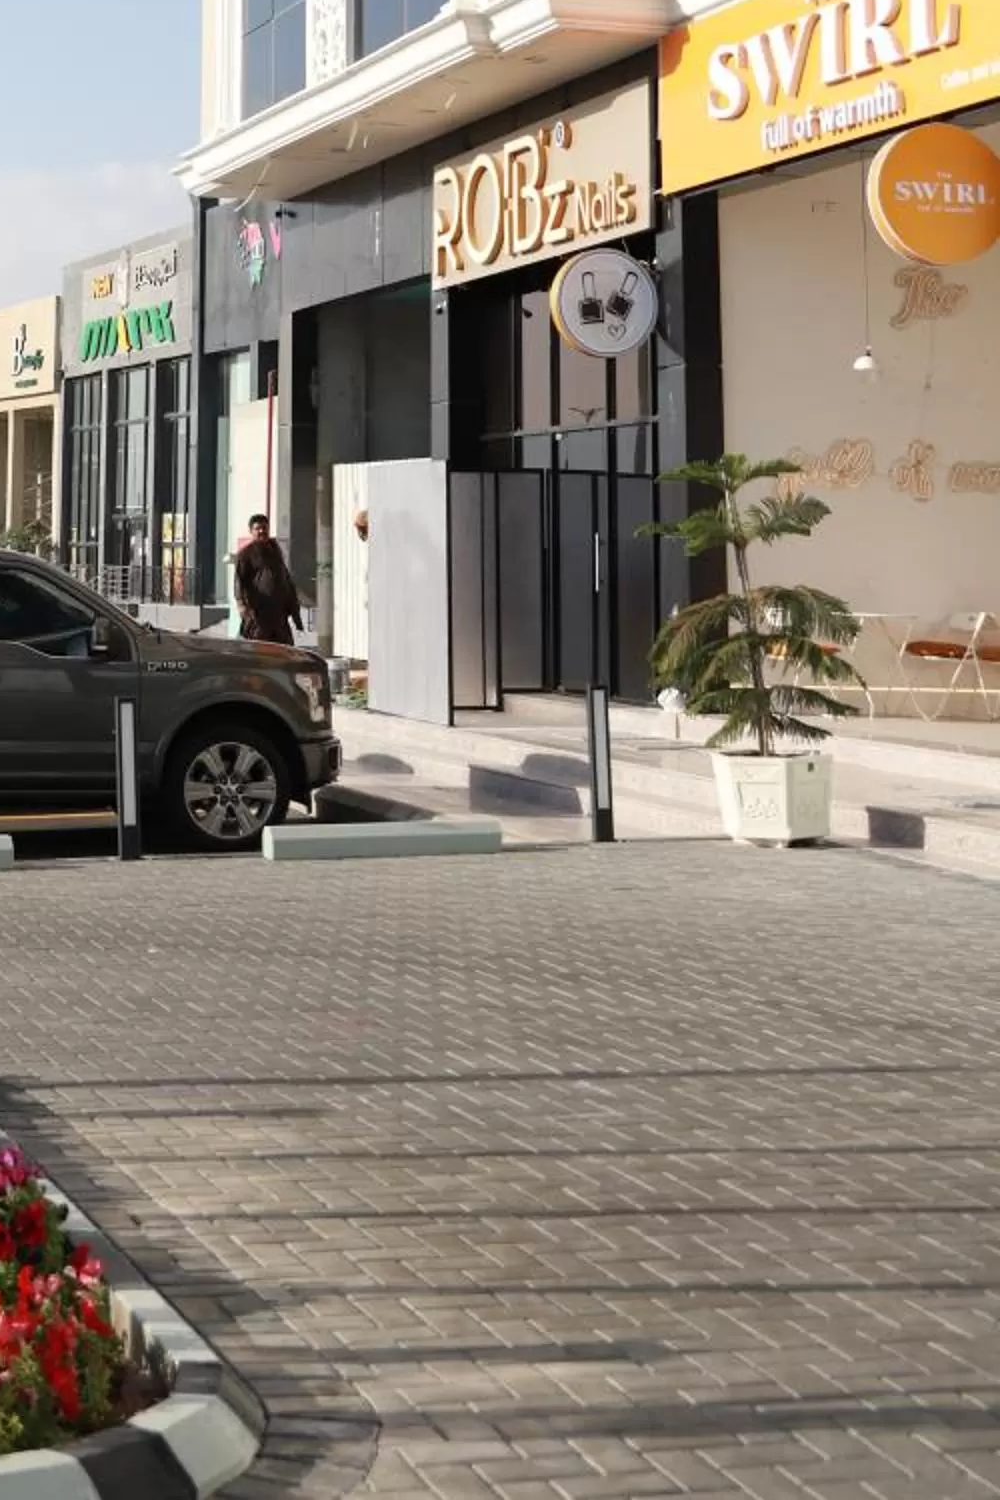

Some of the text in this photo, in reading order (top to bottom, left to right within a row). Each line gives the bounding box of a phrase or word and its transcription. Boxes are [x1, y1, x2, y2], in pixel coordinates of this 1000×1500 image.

[761, 80, 903, 152] full of warmth
[575, 172, 636, 235] Nails
[894, 180, 994, 205] SWIRL
